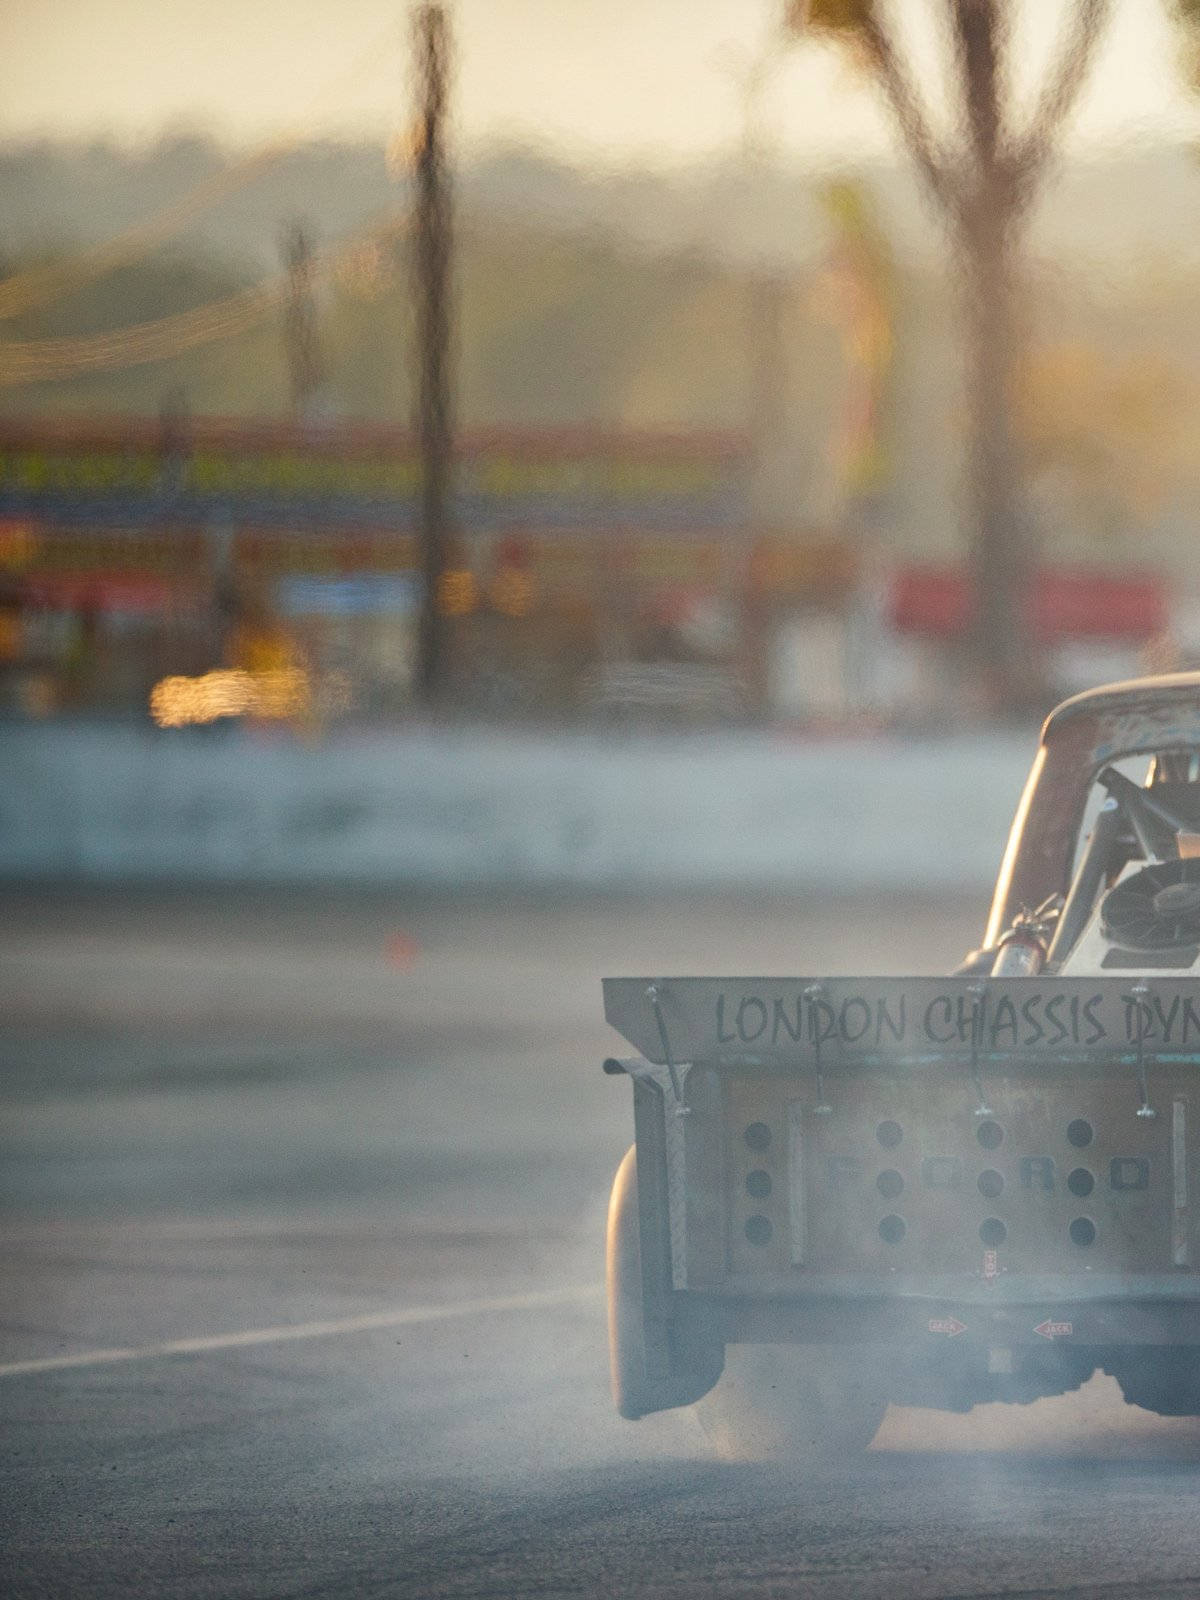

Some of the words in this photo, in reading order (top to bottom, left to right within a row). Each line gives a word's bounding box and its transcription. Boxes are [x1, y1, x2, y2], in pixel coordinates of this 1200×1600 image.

[716, 994, 906, 1044] LONDON
[923, 994, 1107, 1047] CHASSIS
[825, 1155, 1149, 1191] FORD
[931, 1321, 957, 1332] JACK
[1044, 1324, 1070, 1334] JACK
